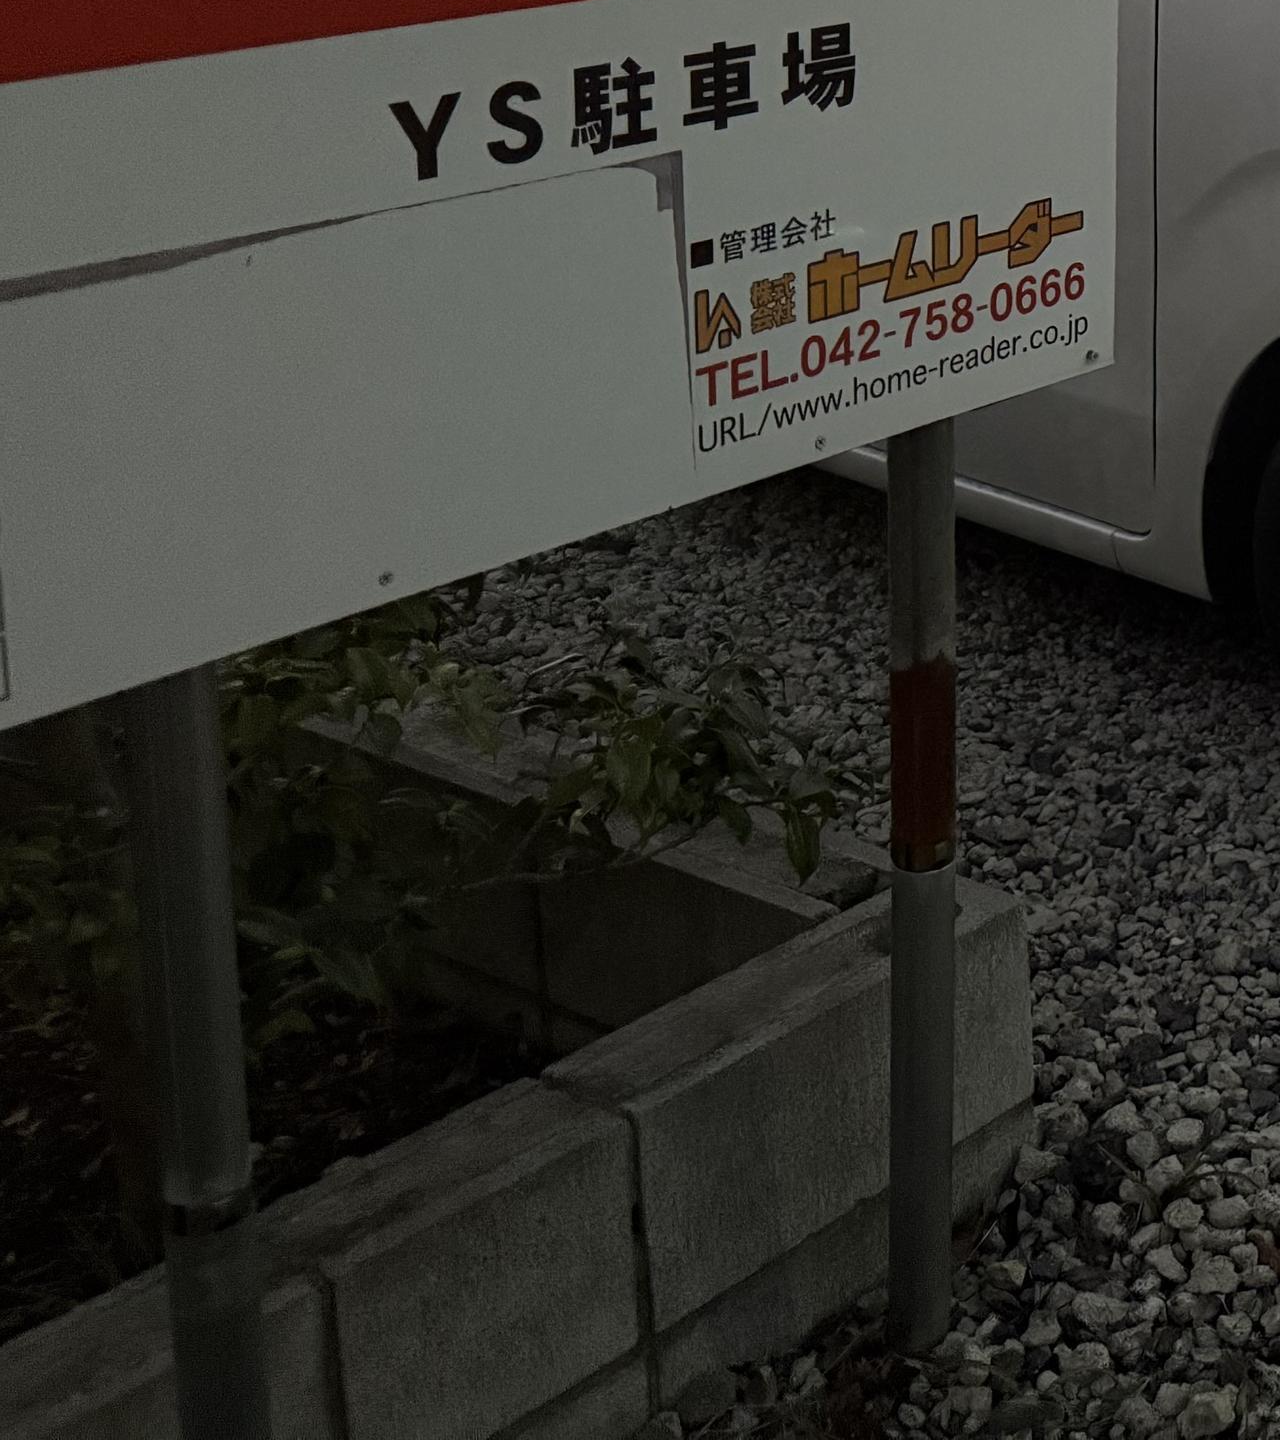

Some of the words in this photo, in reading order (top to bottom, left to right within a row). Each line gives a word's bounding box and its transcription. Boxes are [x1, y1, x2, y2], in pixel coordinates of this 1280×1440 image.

[719, 208, 837, 264] 管理会社
[807, 197, 1084, 324] ホームリーダー
[696, 262, 1086, 407] TEL.042-758-0666
[698, 312, 1089, 453] URL/www.home-reader.co.jp
